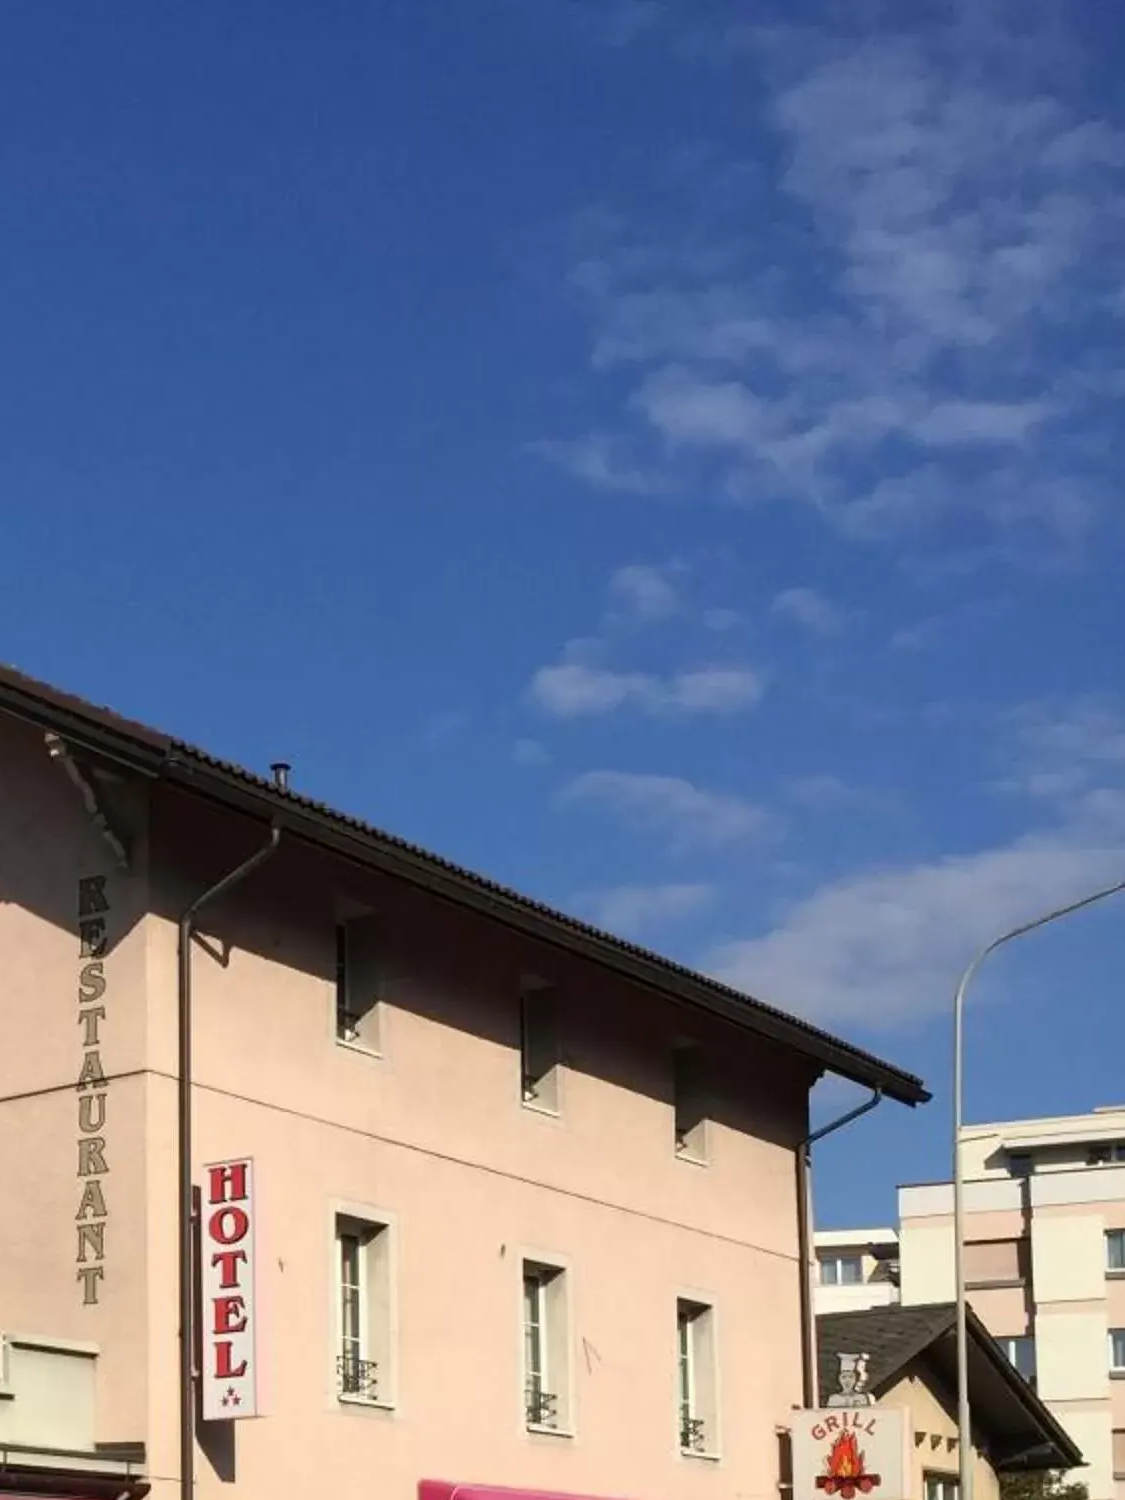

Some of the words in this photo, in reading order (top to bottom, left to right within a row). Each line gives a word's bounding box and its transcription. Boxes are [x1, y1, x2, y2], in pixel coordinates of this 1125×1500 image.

[76, 874, 111, 1305] RESTAURANT
[208, 1163, 249, 1379] HOTEL
[811, 1412, 876, 1440] GRILL
